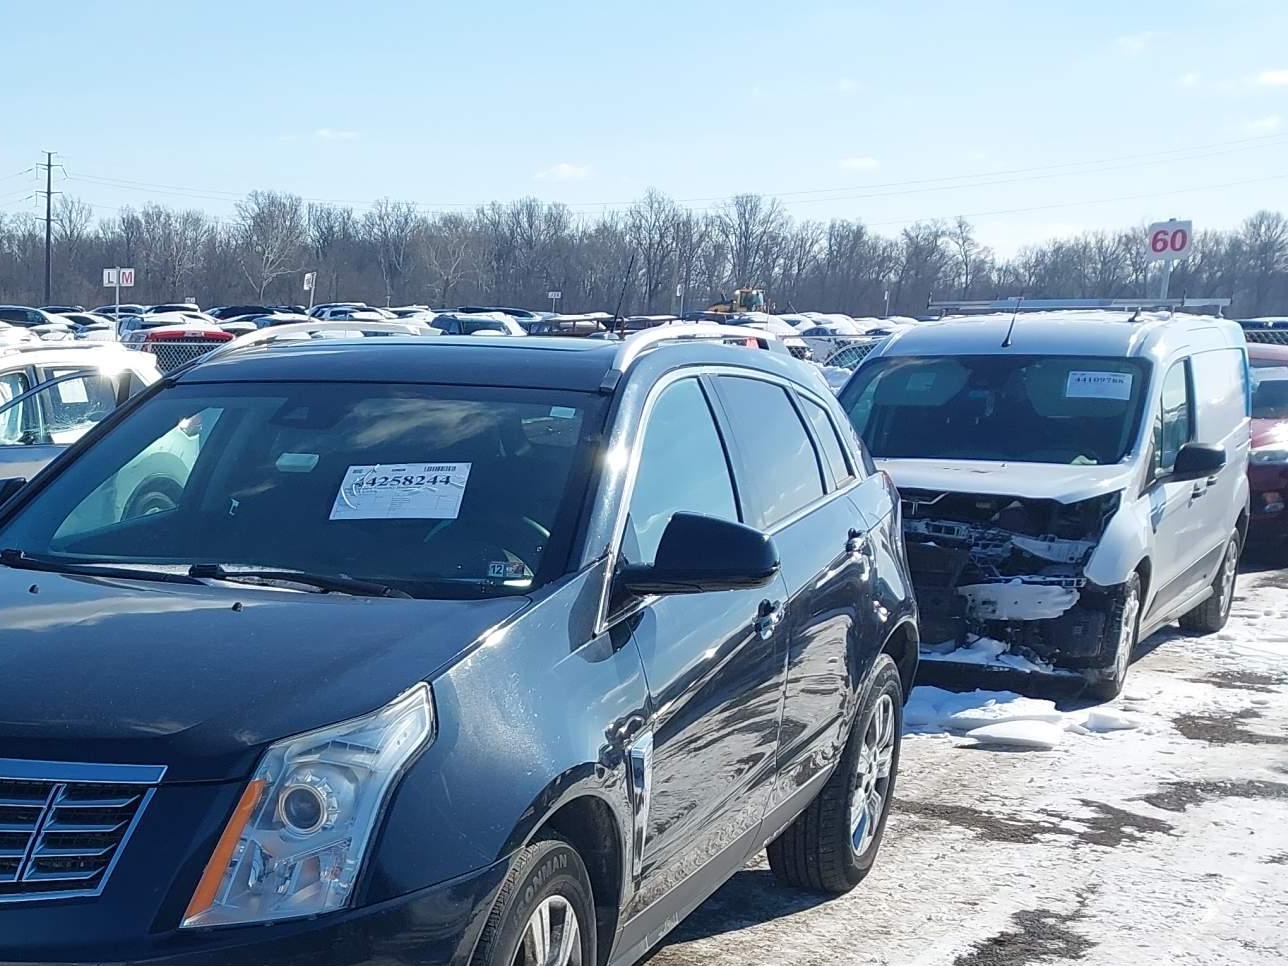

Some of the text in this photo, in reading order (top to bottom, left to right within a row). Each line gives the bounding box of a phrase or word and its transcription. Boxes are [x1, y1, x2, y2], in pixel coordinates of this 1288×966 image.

[1152, 229, 1188, 253] 60
[107, 271, 133, 284] L M
[491, 565, 503, 575] 12
